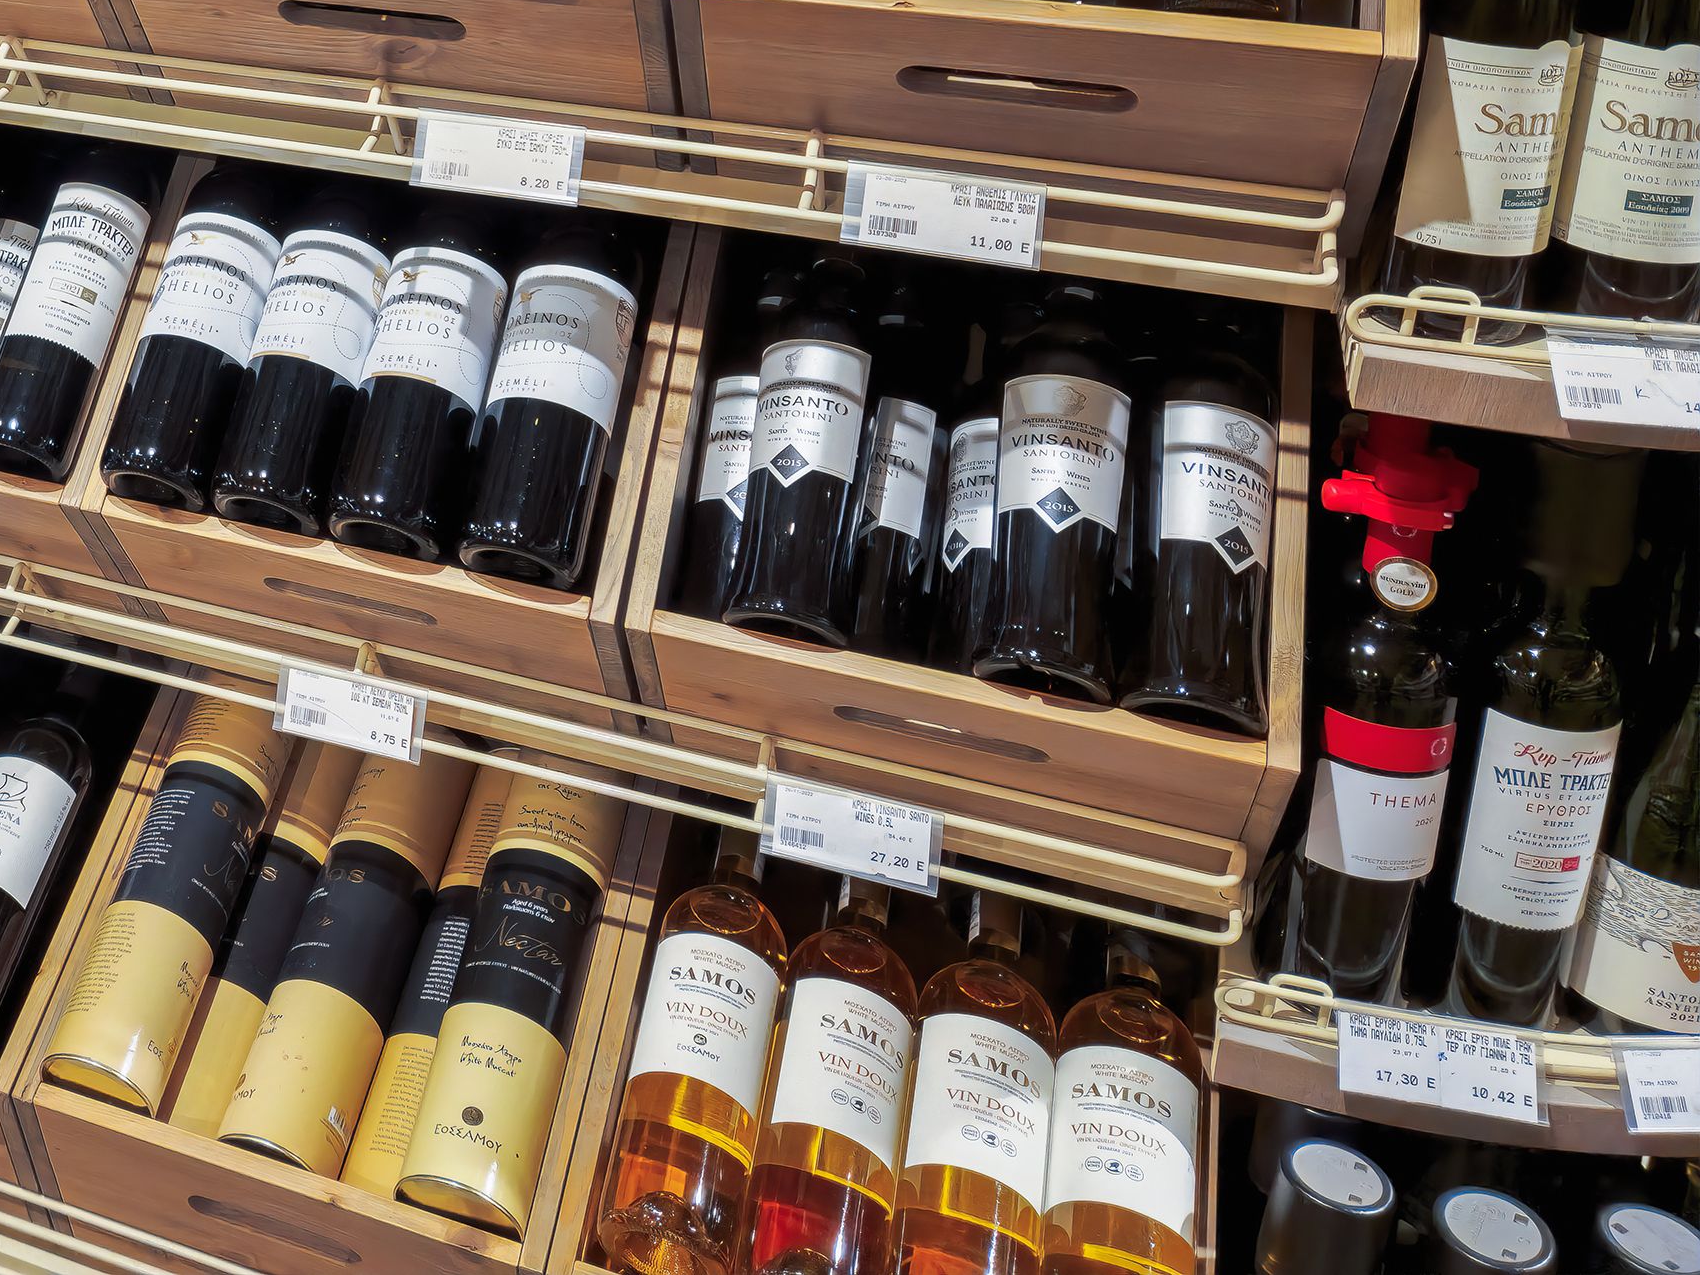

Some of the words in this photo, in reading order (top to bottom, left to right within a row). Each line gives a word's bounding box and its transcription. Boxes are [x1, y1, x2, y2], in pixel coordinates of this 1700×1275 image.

[1453, 150, 1507, 164] APPELLATION
[1632, 157, 1675, 169] D'ORIGINE
[1500, 171, 1532, 181] ΟΙΝΟΣ
[1624, 173, 1661, 185] ΟΙΝΟΣ
[950, 183, 972, 196] ΚΡΑΣΙ
[976, 185, 1007, 200] ΑΝΘΕΜΙΣ
[1009, 190, 1037, 204] ΓΛΥΚΥΣ
[1641, 193, 1681, 204] ΣΑΜΟΣ
[953, 196, 971, 209] ΛΕΥΚ
[974, 198, 1014, 213] ΠΑΛΑΙΩΣΗΣ
[1670, 206, 1690, 215] 2009
[51, 215, 88, 231] ΜΠΛΕ
[92, 218, 135, 257] ΤΡΑΚΤΕΡ
[969, 235, 1013, 252] 11,00
[68, 239, 110, 261] ΛΕΥΚΟΣ
[172, 255, 248, 282] OREINOS
[60, 282, 81, 294] 2021
[167, 278, 235, 305] HELIOS
[271, 275, 338, 293] OREINOS
[264, 300, 326, 317] HELIOS
[386, 293, 463, 315] OREINOS
[383, 317, 451, 339] HELIOS
[507, 312, 580, 331] OREINOS
[502, 340, 569, 356] HELIOS
[1644, 347, 1669, 360] ΚΡΑΣΙ
[1652, 360, 1673, 372] ΛΕΥΚ
[756, 395, 849, 416] VINSANTO
[764, 409, 834, 423] SANTORINI
[1021, 418, 1065, 428] NATURALLY
[1011, 433, 1115, 463] VINSANTO
[1195, 446, 1241, 462] NATURALLY
[776, 457, 802, 468] 2015
[1022, 447, 1102, 469] SANTORINI
[1198, 478, 1268, 512] SANTORINI
[1044, 501, 1074, 514] 2015
[1223, 539, 1250, 555] 2015
[1390, 585, 1414, 597] GOLD
[370, 730, 396, 745] 8,75
[1493, 765, 1552, 791] ΜΠΛΕ
[1370, 792, 1437, 808] THEMA
[1498, 787, 1551, 800] VIRTUS
[852, 798, 872, 813] ΚΡΑΣΙ
[875, 803, 906, 819] VINSANTO
[909, 810, 930, 824] SANTO
[855, 811, 875, 824] WINES
[1525, 802, 1591, 817] ΕΡΥΘΡΟΣ
[870, 851, 909, 868] 27,20
[916, 860, 925, 872] E
[1532, 859, 1561, 870] 2020
[511, 898, 527, 908] Aged
[533, 903, 550, 914] years
[474, 915, 563, 967] Nectar
[669, 966, 756, 1006] SAMOS
[665, 1000, 695, 1015] VIN
[699, 1006, 748, 1038] DOUX
[1350, 1014, 1372, 1027] ΚΡΑΣΙ
[1375, 1017, 1400, 1032] ΕΡΥΘΡΟ
[1401, 1021, 1428, 1036] THEMA
[1670, 1012, 1700, 1023] 2021
[820, 1013, 904, 1069] SAMOS
[1350, 1027, 1367, 1039] ΤΗΜΑ
[1369, 1029, 1402, 1044] ΠΑΥΛΙΔΗ
[1445, 1029, 1468, 1042] ΚΡΑΣΙ
[975, 1040, 997, 1053] WHITE
[1445, 1040, 1460, 1053] ΤΕΡ
[1463, 1043, 1478, 1056] ΚΥΡ
[1480, 1046, 1507, 1062] ΓΙΑΝΝΗ
[460, 1052, 482, 1066] White
[485, 1057, 517, 1077] Muscat
[818, 1050, 851, 1070] VIN
[855, 1063, 899, 1102] DOUX
[947, 1049, 1041, 1099] SAMOS
[1376, 1070, 1419, 1087] 17,30
[1071, 1082, 1172, 1118] SAMOS
[1472, 1085, 1516, 1104] 10,42
[946, 1088, 981, 1105] VIN
[986, 1098, 1035, 1135] DOUX
[434, 1123, 502, 1154] ΕΟΣΣΑΜΟΥ
[1070, 1123, 1102, 1136] VIN
[1108, 1124, 1167, 1156] DOUX
